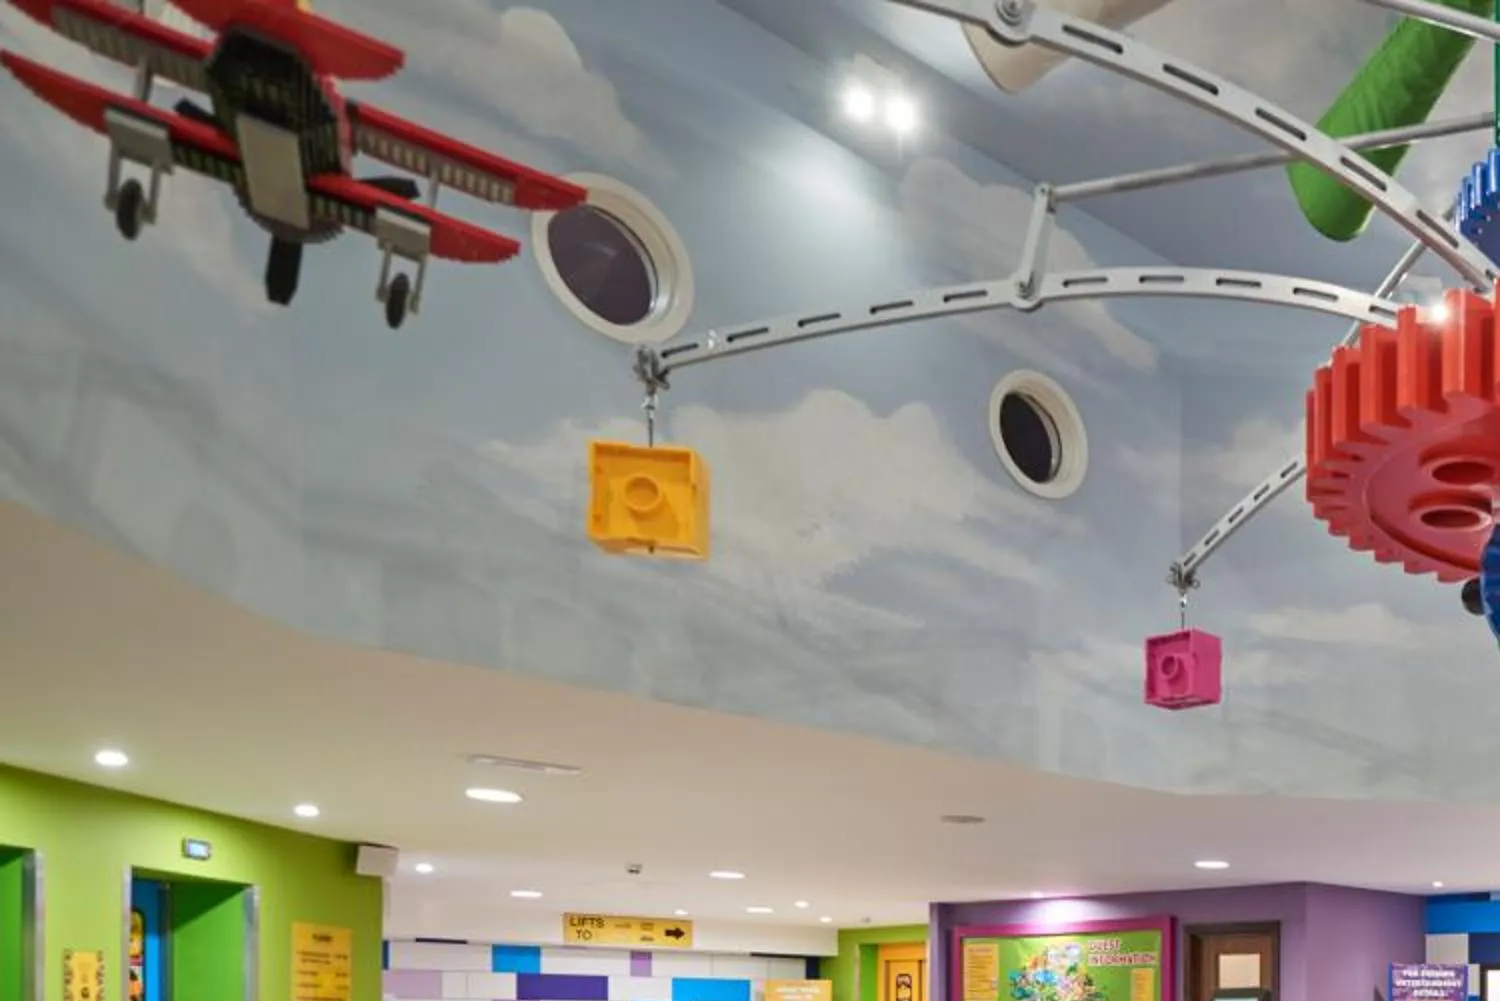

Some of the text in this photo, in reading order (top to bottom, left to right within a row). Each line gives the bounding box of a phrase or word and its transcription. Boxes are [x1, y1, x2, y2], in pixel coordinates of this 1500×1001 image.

[569, 915, 605, 929] LIFTS
[575, 928, 593, 941] TO
[1089, 939, 1121, 951] GUEST
[1089, 953, 1156, 966] INFORMATION
